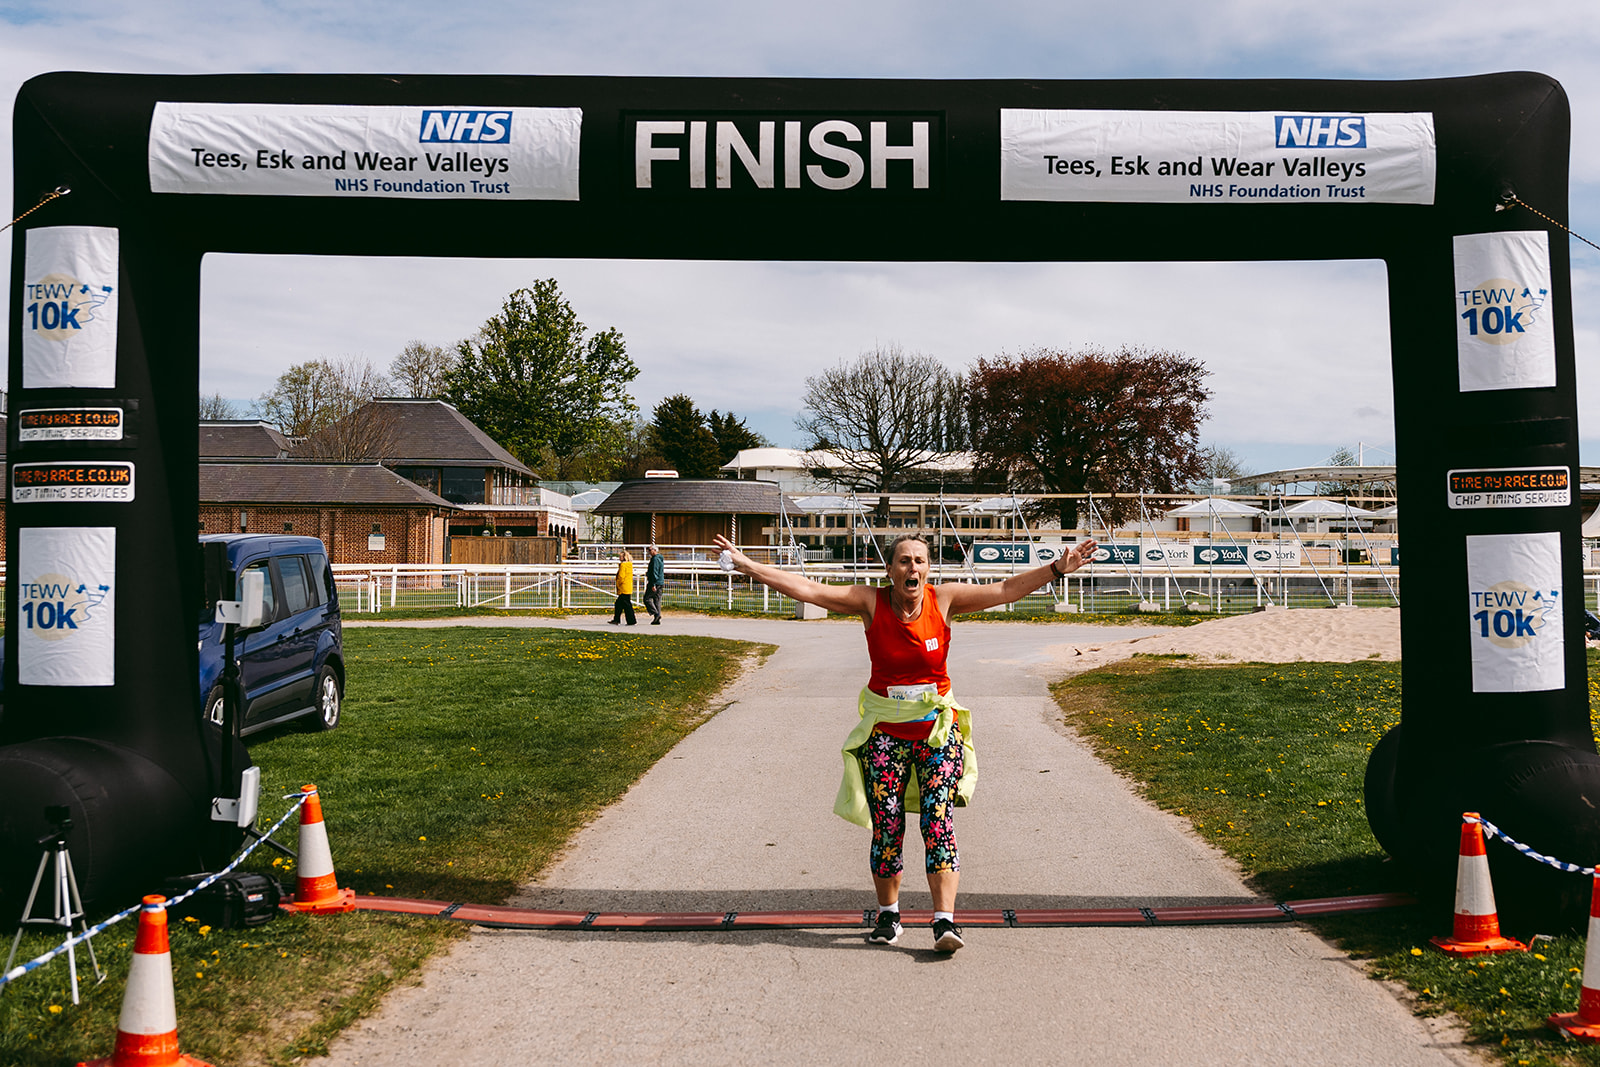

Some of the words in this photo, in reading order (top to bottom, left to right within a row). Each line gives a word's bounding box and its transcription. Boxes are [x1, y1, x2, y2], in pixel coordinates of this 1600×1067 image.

[422, 111, 510, 141] NHS
[1278, 116, 1363, 147] NHS
[636, 120, 928, 189] FINISH
[191, 148, 247, 170] Tees,
[257, 150, 294, 169] Esk
[302, 150, 345, 170] and
[354, 152, 417, 171] Wear
[426, 152, 508, 177] Valleys
[1044, 156, 1101, 177] Tees,
[1111, 156, 1149, 175] Esk
[1158, 156, 1202, 176] and
[1211, 158, 1275, 176] Wear
[1283, 157, 1365, 182] Valleys
[336, 179, 368, 191] NHS
[374, 179, 465, 192] Foundation
[470, 181, 510, 193] Trust
[1190, 185, 1223, 197] NHS
[1229, 184, 1320, 197] Foundation
[1326, 185, 1365, 197] Trust
[27, 284, 74, 299] TEWV
[1459, 288, 1515, 305] TEWV
[27, 301, 82, 330] 10k
[1461, 305, 1525, 335] 10k
[71, 428, 118, 438] SERVICES
[70, 487, 128, 498] SERVICES
[1455, 495, 1481, 506] CHIP
[1486, 494, 1521, 505] TIMING
[1525, 492, 1567, 503] SERVICES
[1001, 548, 1024, 557] York
[1112, 548, 1134, 558] York
[1168, 550, 1189, 558] York
[1221, 549, 1242, 559] York
[1275, 550, 1295, 559] York
[21, 584, 70, 599] TEWV
[1471, 591, 1527, 607] TEWV
[22, 601, 78, 629] 10k
[1473, 609, 1536, 638] 10k
